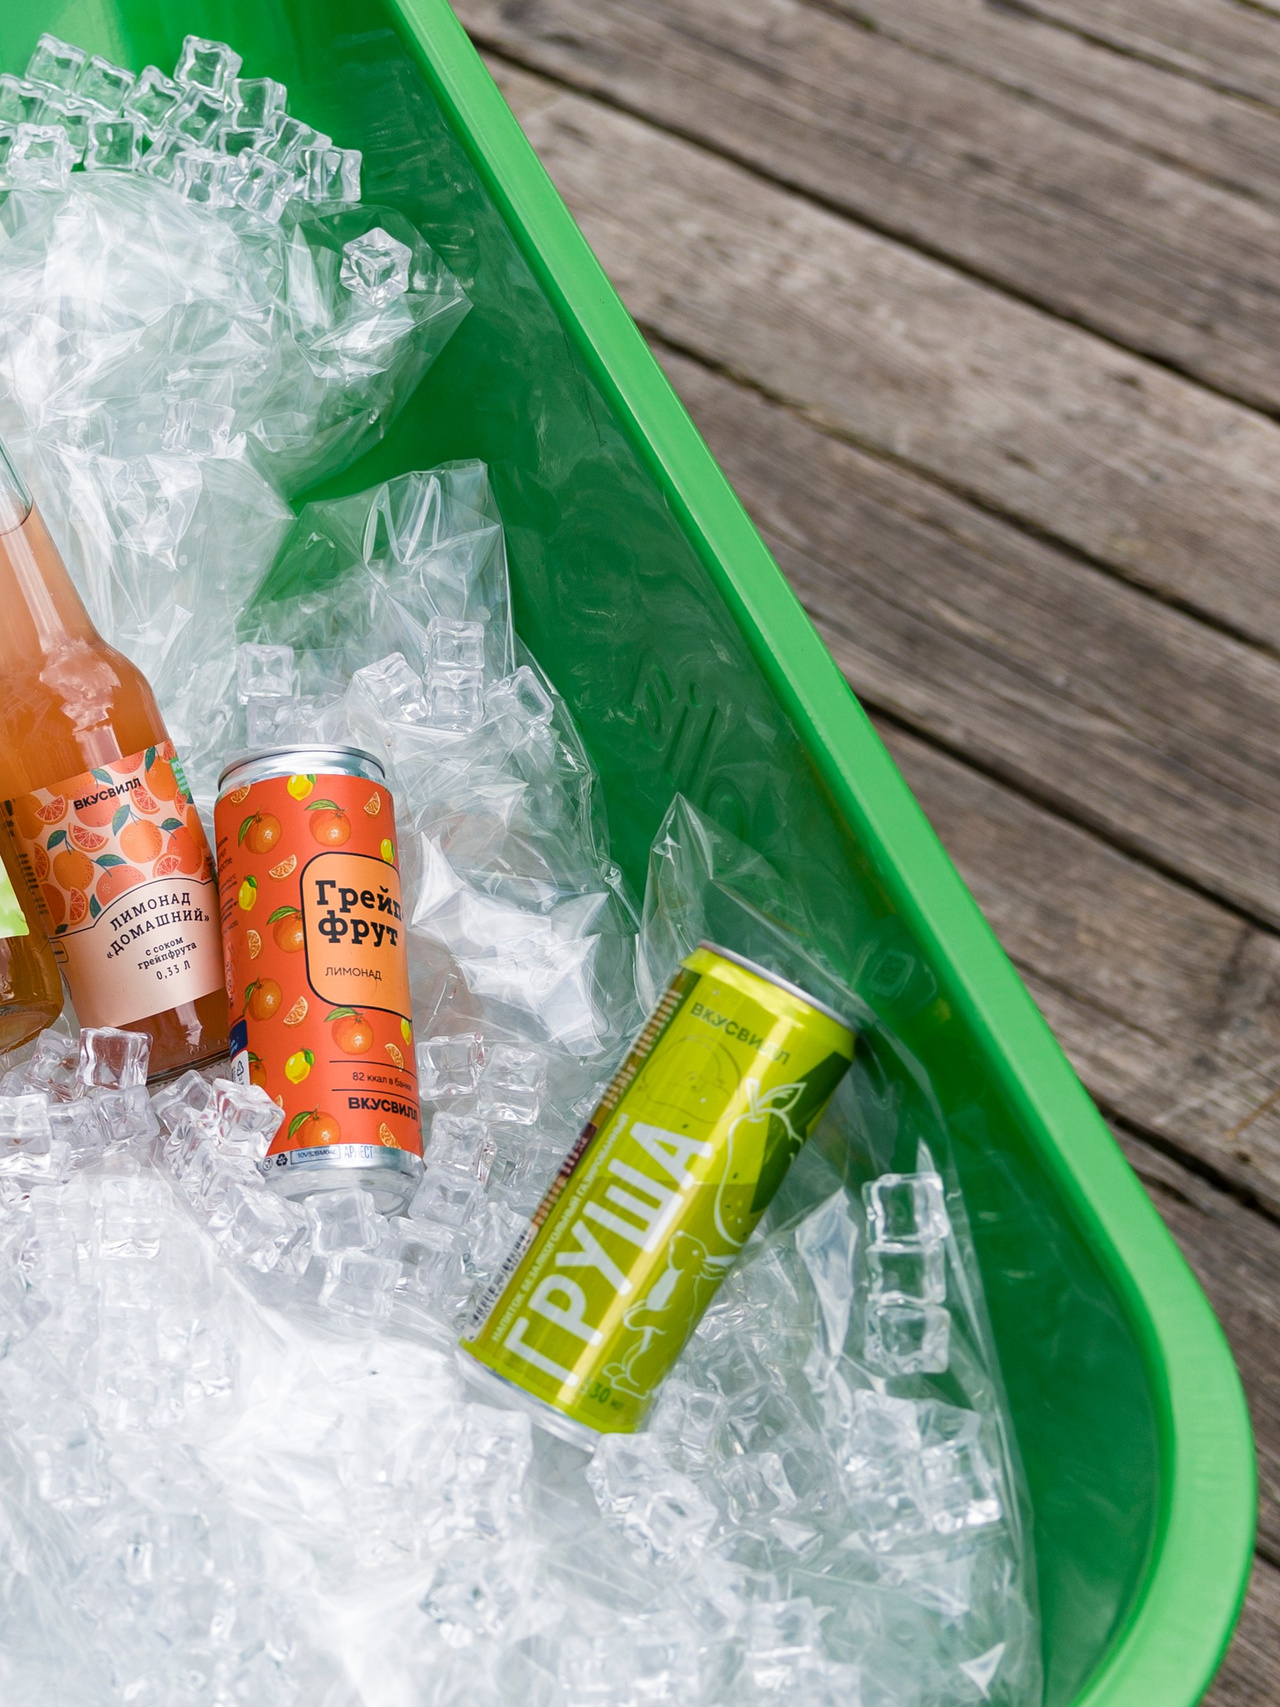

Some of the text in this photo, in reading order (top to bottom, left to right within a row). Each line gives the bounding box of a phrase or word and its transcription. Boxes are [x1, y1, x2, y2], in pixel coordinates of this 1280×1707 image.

[73, 777, 142, 811] ВКУСВИЛЛ
[110, 892, 191, 931] ЛИМОНАД
[315, 880, 403, 922] Грейп
[106, 908, 210, 959] «ДОМАШНИЙ»
[153, 937, 184, 953] соком
[137, 942, 197, 970] грейпфрута
[156, 964, 180, 980] 0,33
[325, 967, 382, 981] ЛИМОНАД
[352, 1072, 365, 1081] 82
[367, 1075, 387, 1084] ккал
[348, 1097, 418, 1122] ВКУСВИЛЛ
[505, 1121, 712, 1387] ГРУША
